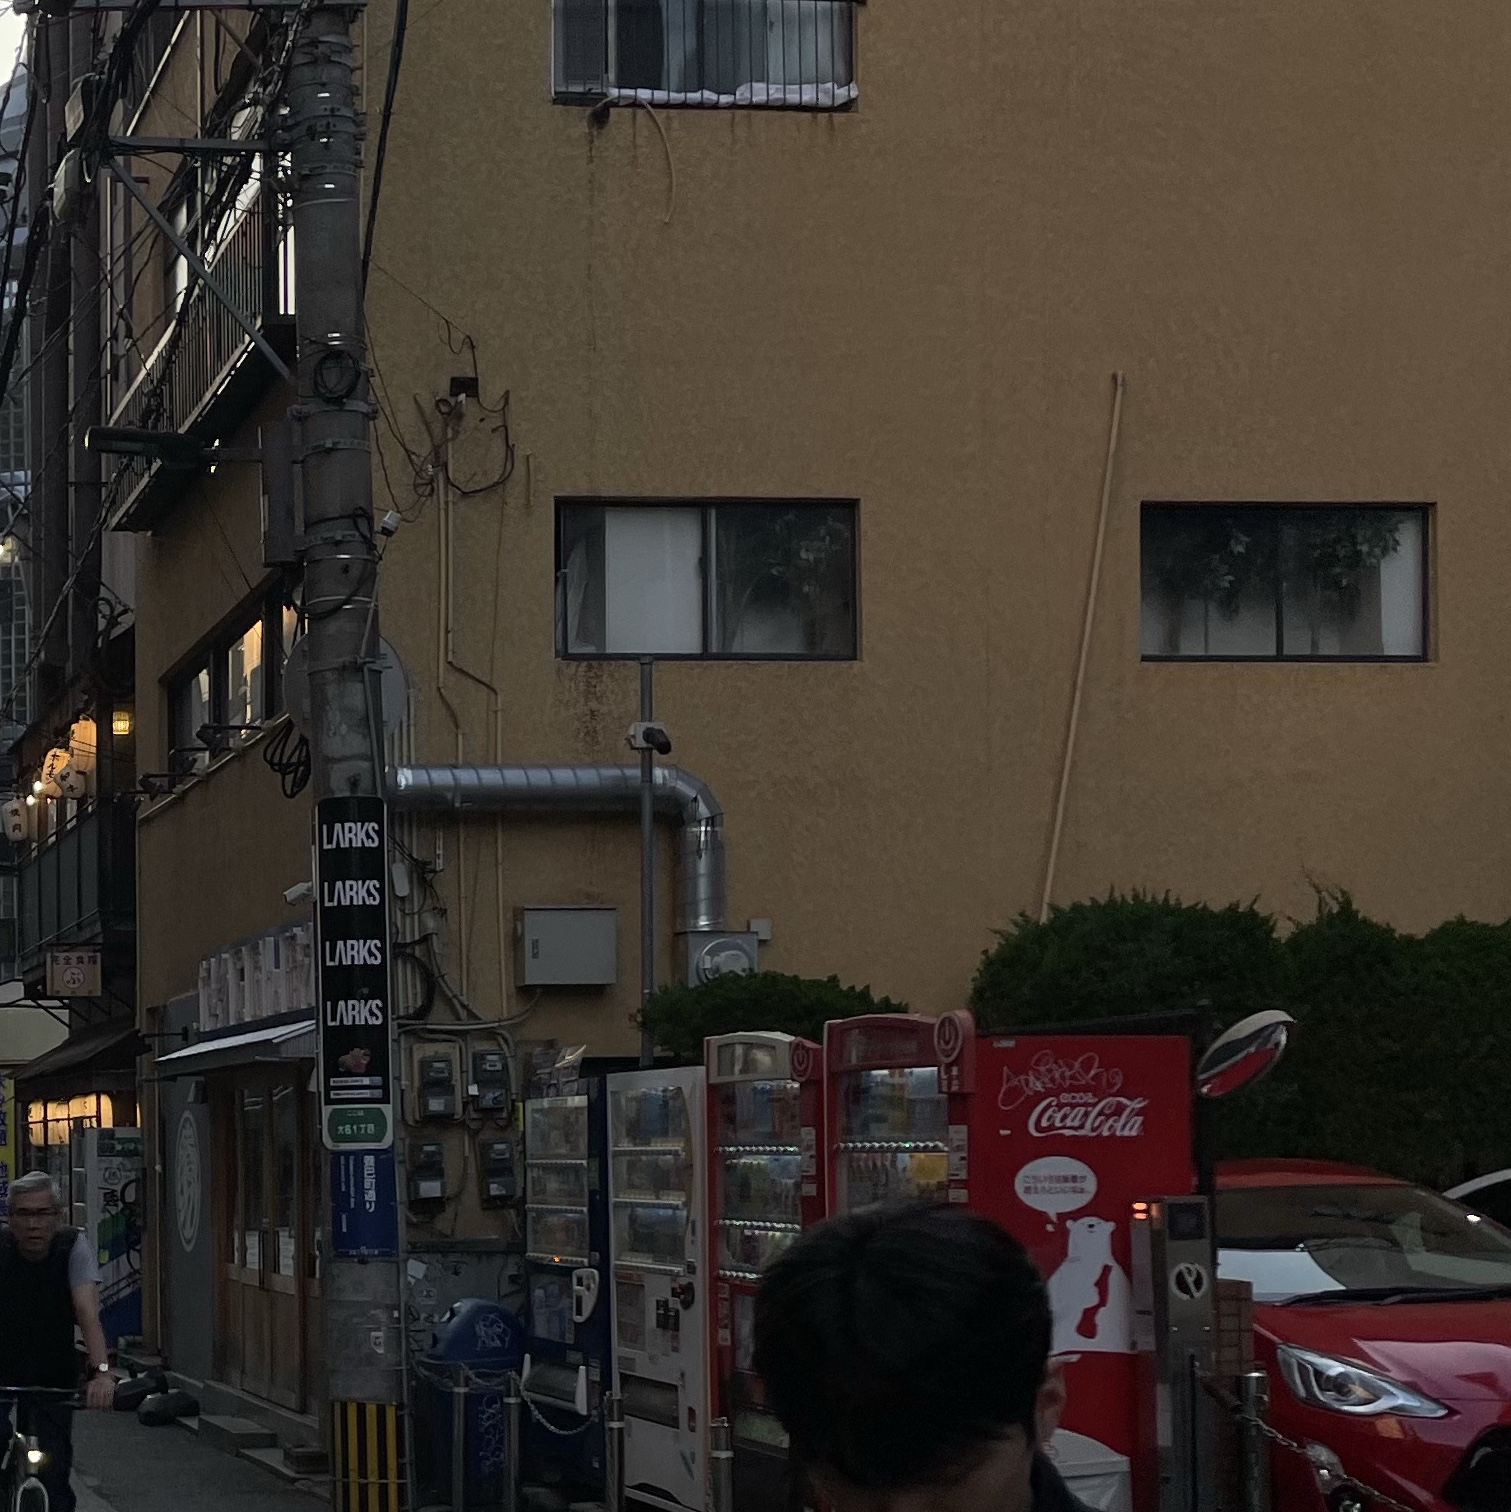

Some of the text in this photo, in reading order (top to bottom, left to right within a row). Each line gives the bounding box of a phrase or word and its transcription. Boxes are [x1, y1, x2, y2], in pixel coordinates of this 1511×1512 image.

[323, 822, 379, 850] LARKS
[324, 880, 380, 907] LARKS
[325, 939, 382, 967] LARKS
[326, 999, 383, 1026] LARKS
